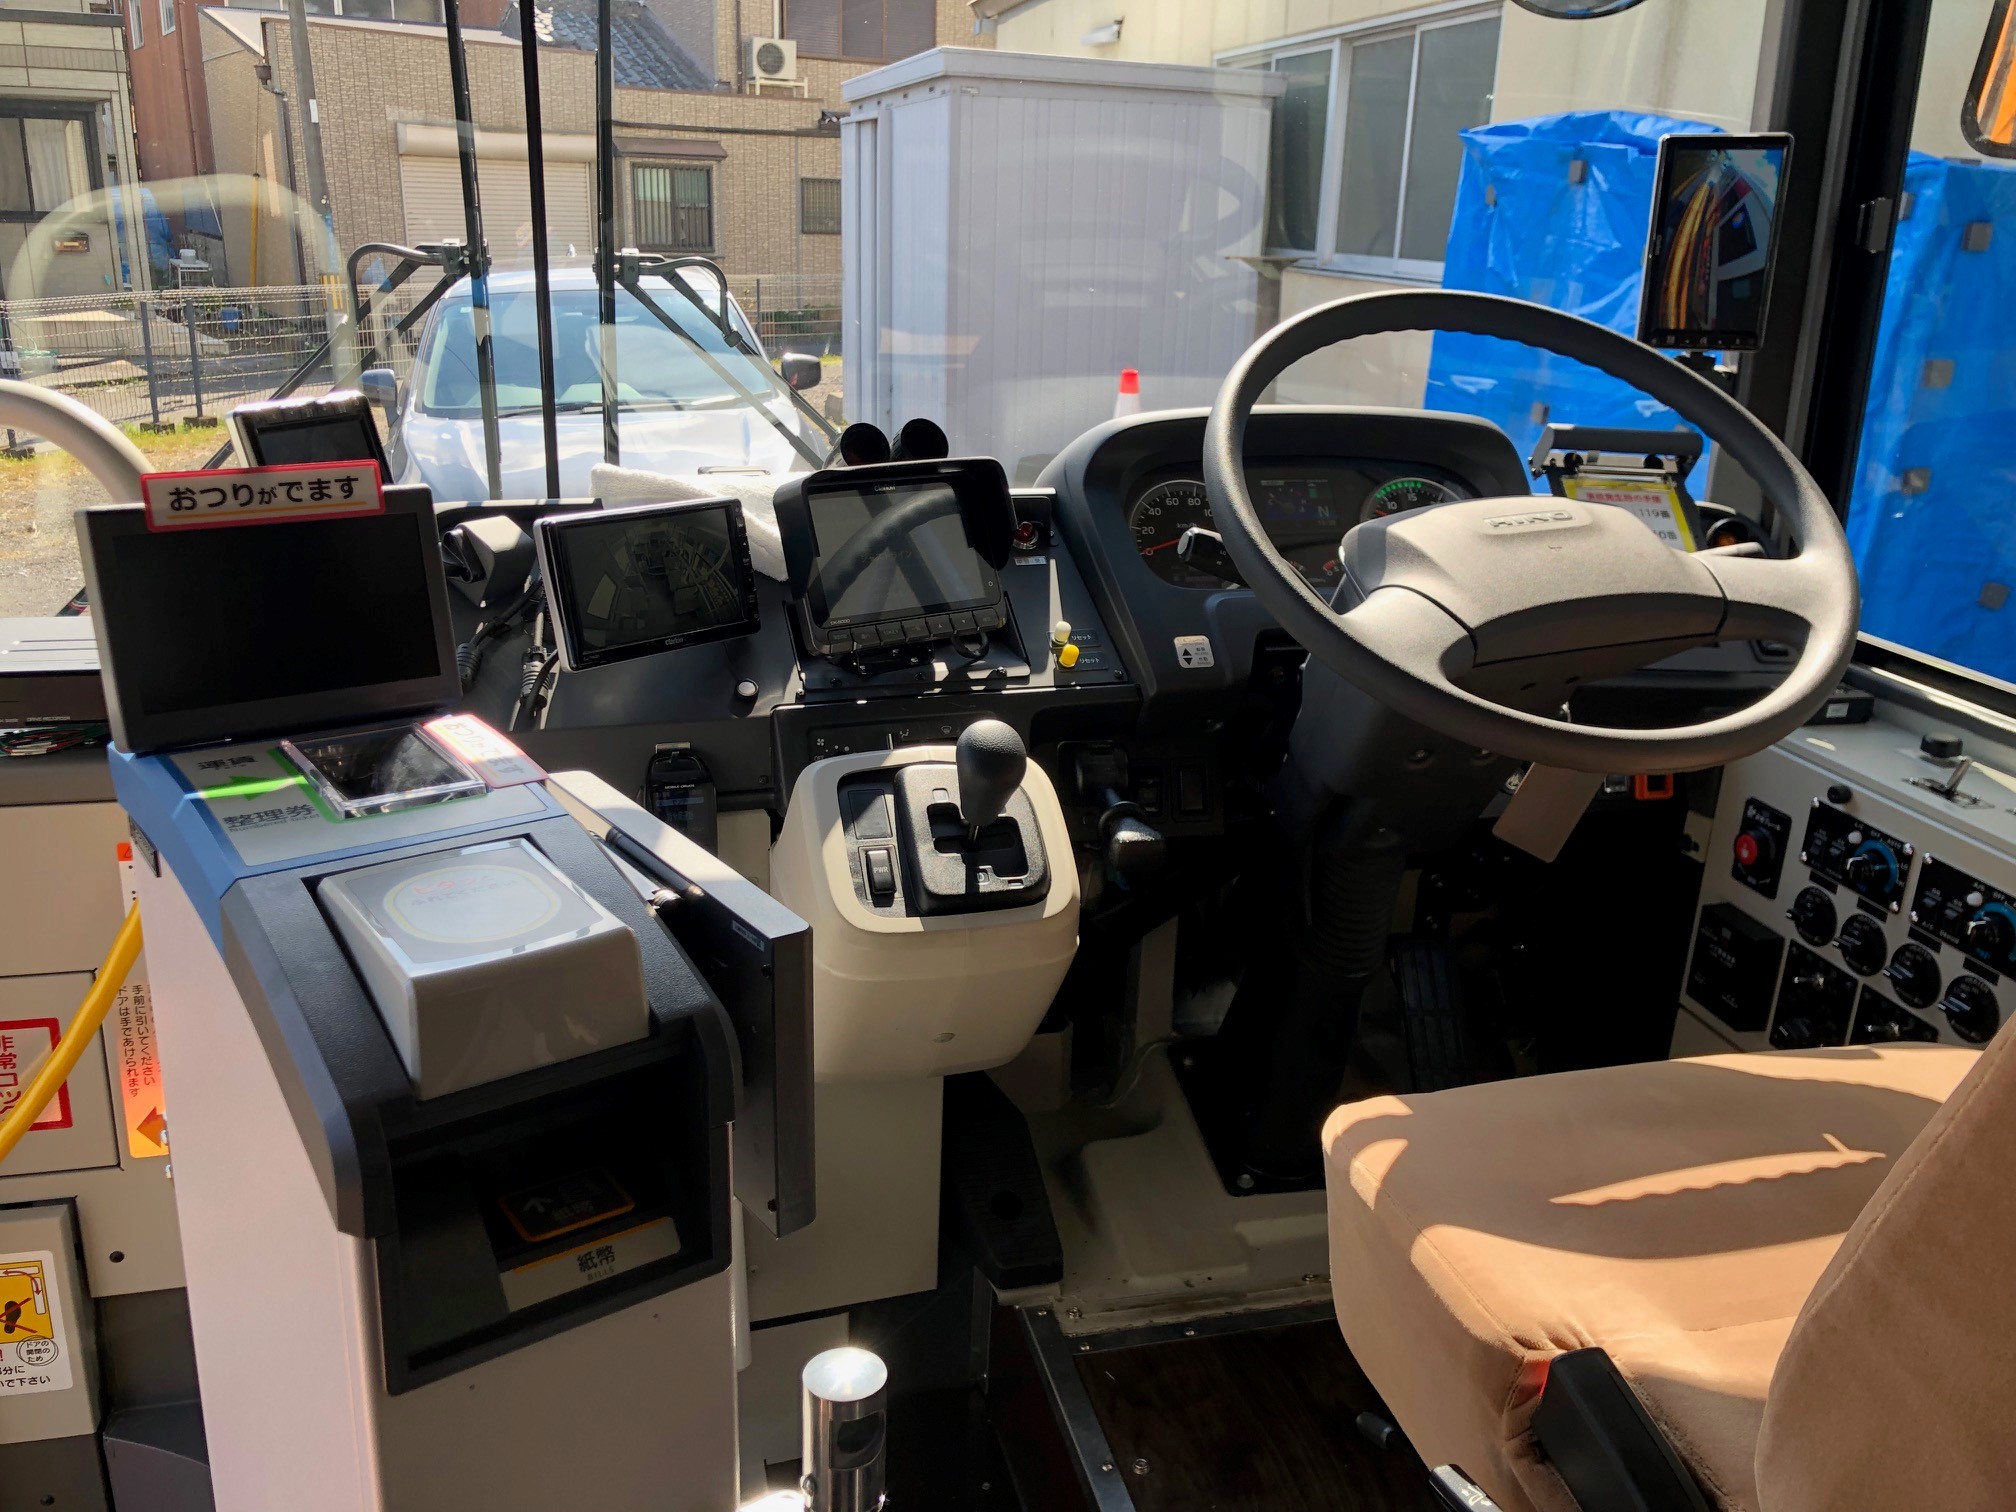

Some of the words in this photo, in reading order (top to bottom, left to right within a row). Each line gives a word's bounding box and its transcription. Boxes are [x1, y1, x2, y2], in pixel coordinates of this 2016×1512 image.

[169, 475, 359, 512] おつりがでます
[1407, 493, 1418, 502] 15
[1165, 497, 1180, 506] 60
[1187, 497, 1202, 506] 80
[1387, 501, 1398, 510] 10
[1148, 507, 1162, 516] 40
[1204, 508, 1213, 517] 10
[1317, 505, 1330, 518] N
[1489, 511, 1574, 528] HINO
[1141, 526, 1155, 535] 20
[1653, 530, 1678, 540] 0番
[222, 804, 316, 829] 整理券
[873, 866, 889, 875] PWR
[132, 984, 155, 1086] 手前に引いてください
[117, 985, 139, 1097] ドアは手であけられます
[577, 1245, 615, 1273] 紙幣
[587, 1265, 614, 1281] BILLS
[27, 1340, 49, 1348] ドアの
[27, 1355, 43, 1363] ため
